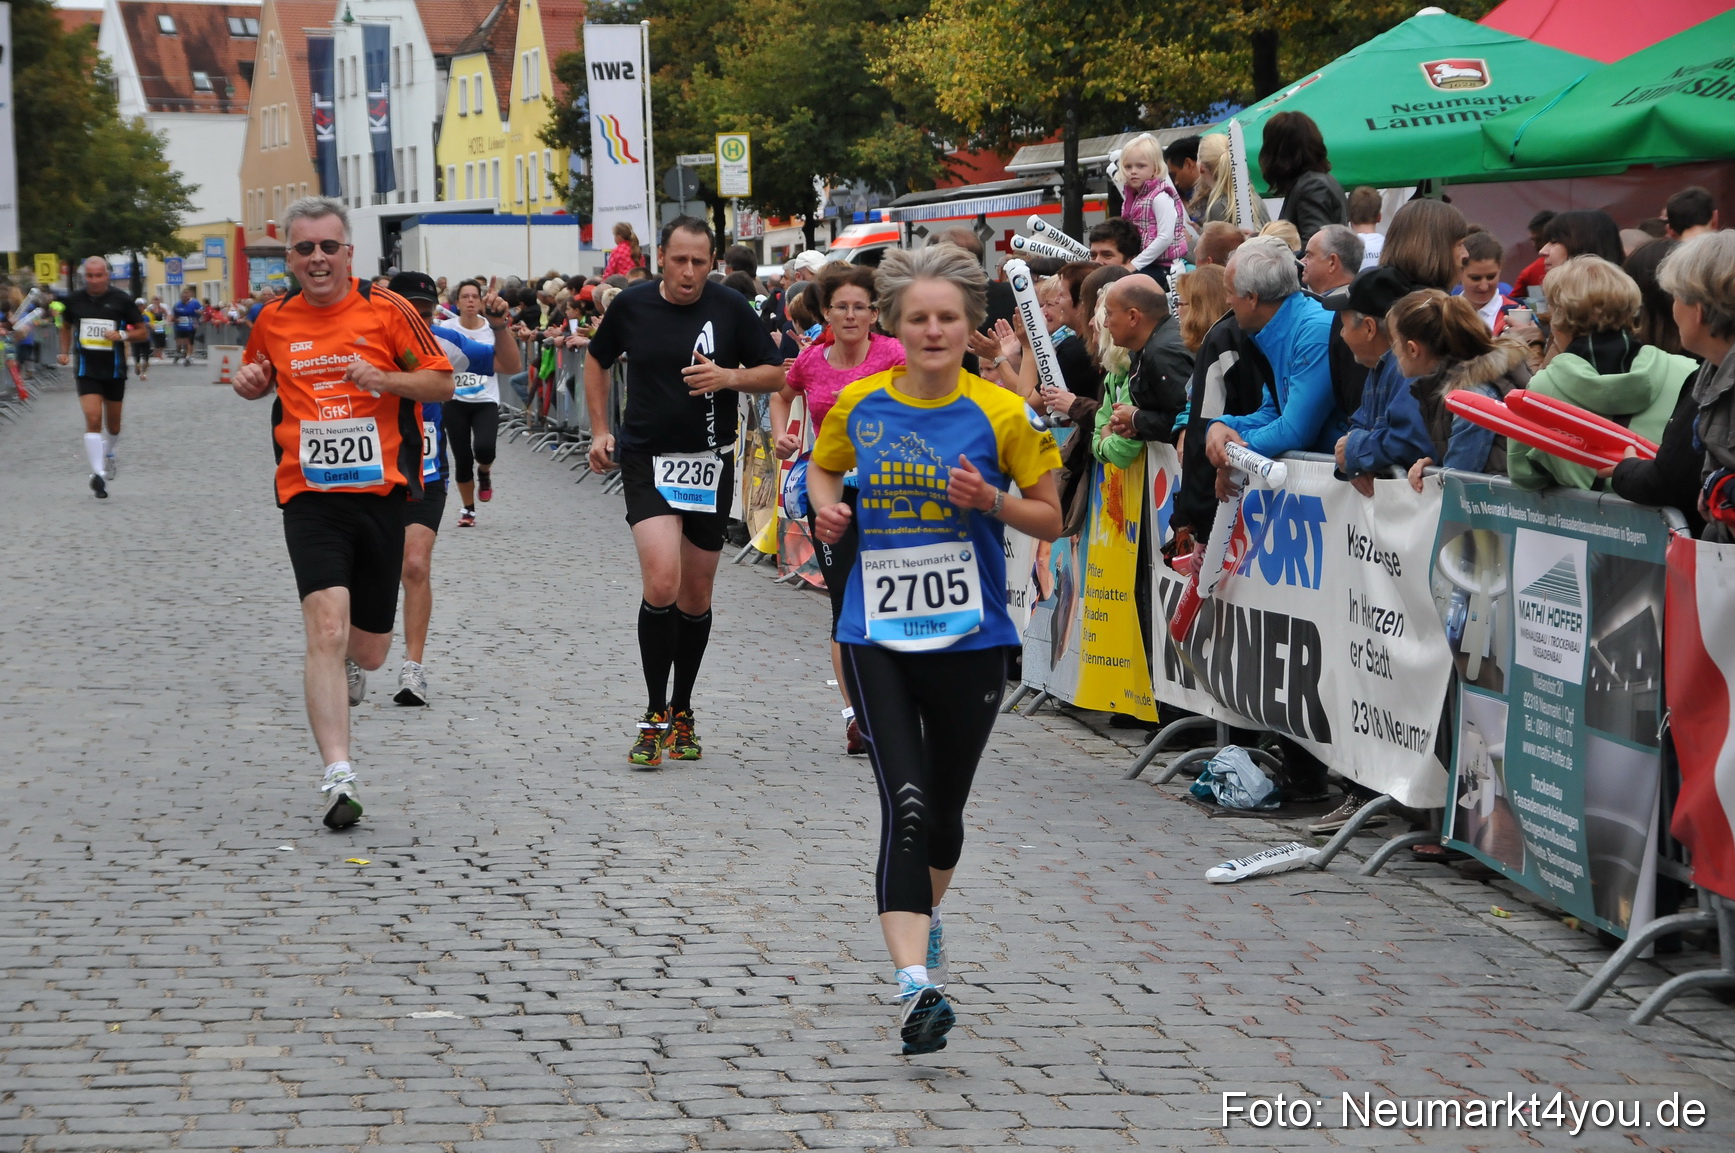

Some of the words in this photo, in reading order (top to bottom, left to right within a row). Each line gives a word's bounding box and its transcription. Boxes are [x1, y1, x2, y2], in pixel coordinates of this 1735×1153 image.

[1365, 106, 1507, 131] Lamms
[467, 136, 485, 155] HOTEL
[727, 144, 739, 156] H
[1047, 227, 1071, 249] BMW
[1029, 241, 1053, 257] BMW
[167, 276, 183, 284] TAXI
[290, 352, 362, 370] SportScheck
[322, 403, 349, 419] GfK
[302, 427, 324, 435] PARTL
[326, 425, 364, 435] Neumarkt
[308, 436, 373, 465] 2520
[324, 471, 359, 481] Gerald
[662, 460, 716, 486] 2236
[672, 490, 703, 502] Thomas
[822, 541, 833, 567] dlo
[865, 560, 900, 570] PARTL
[902, 553, 955, 568] Neumarkt
[876, 567, 970, 613] 2705
[1519, 600, 1546, 624] MATHI
[1548, 607, 1583, 633] HOFFER
[903, 620, 947, 637] Ulrike
[1531, 773, 1563, 801] Trockenbau
